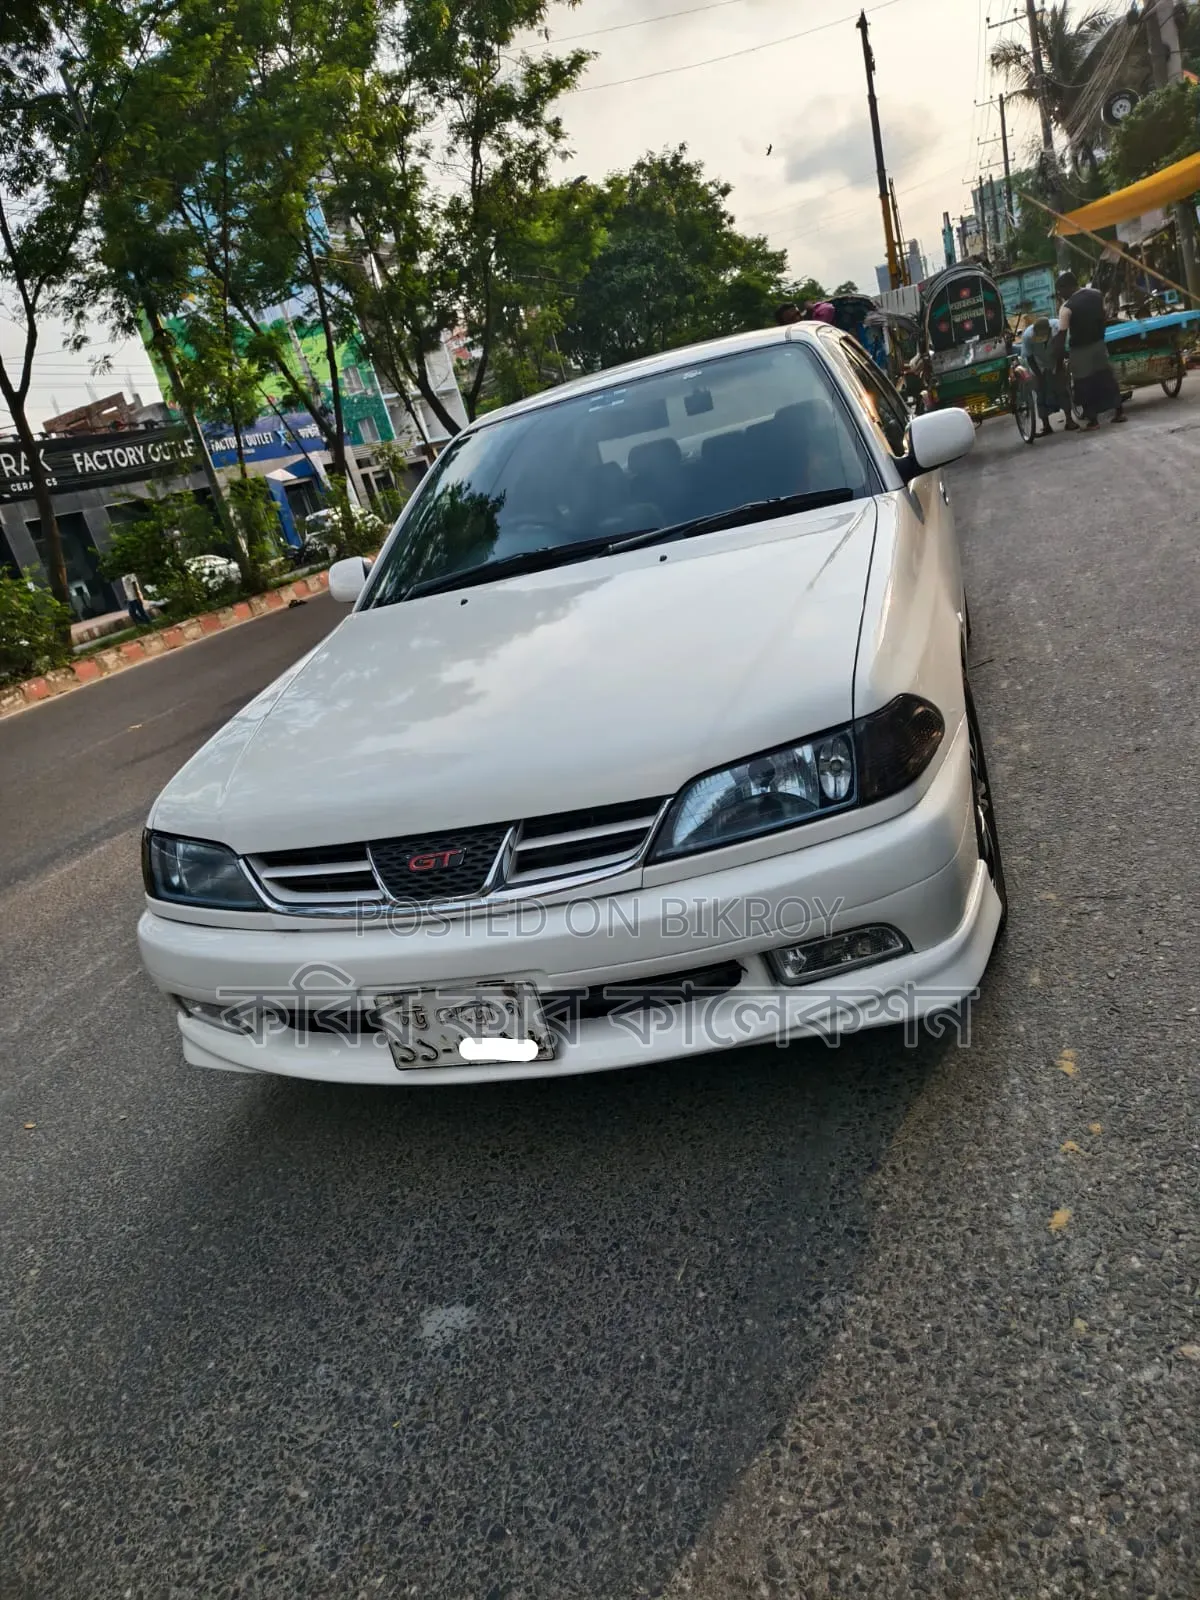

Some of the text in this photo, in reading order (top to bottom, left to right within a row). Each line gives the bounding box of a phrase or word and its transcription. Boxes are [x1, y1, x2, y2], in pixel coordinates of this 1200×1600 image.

[245, 432, 273, 446] OUTLET
[72, 445, 146, 473] FACTORY
[147, 438, 195, 462] OUTLE
[10, 477, 58, 492] CERACS
[408, 848, 463, 872] GT
